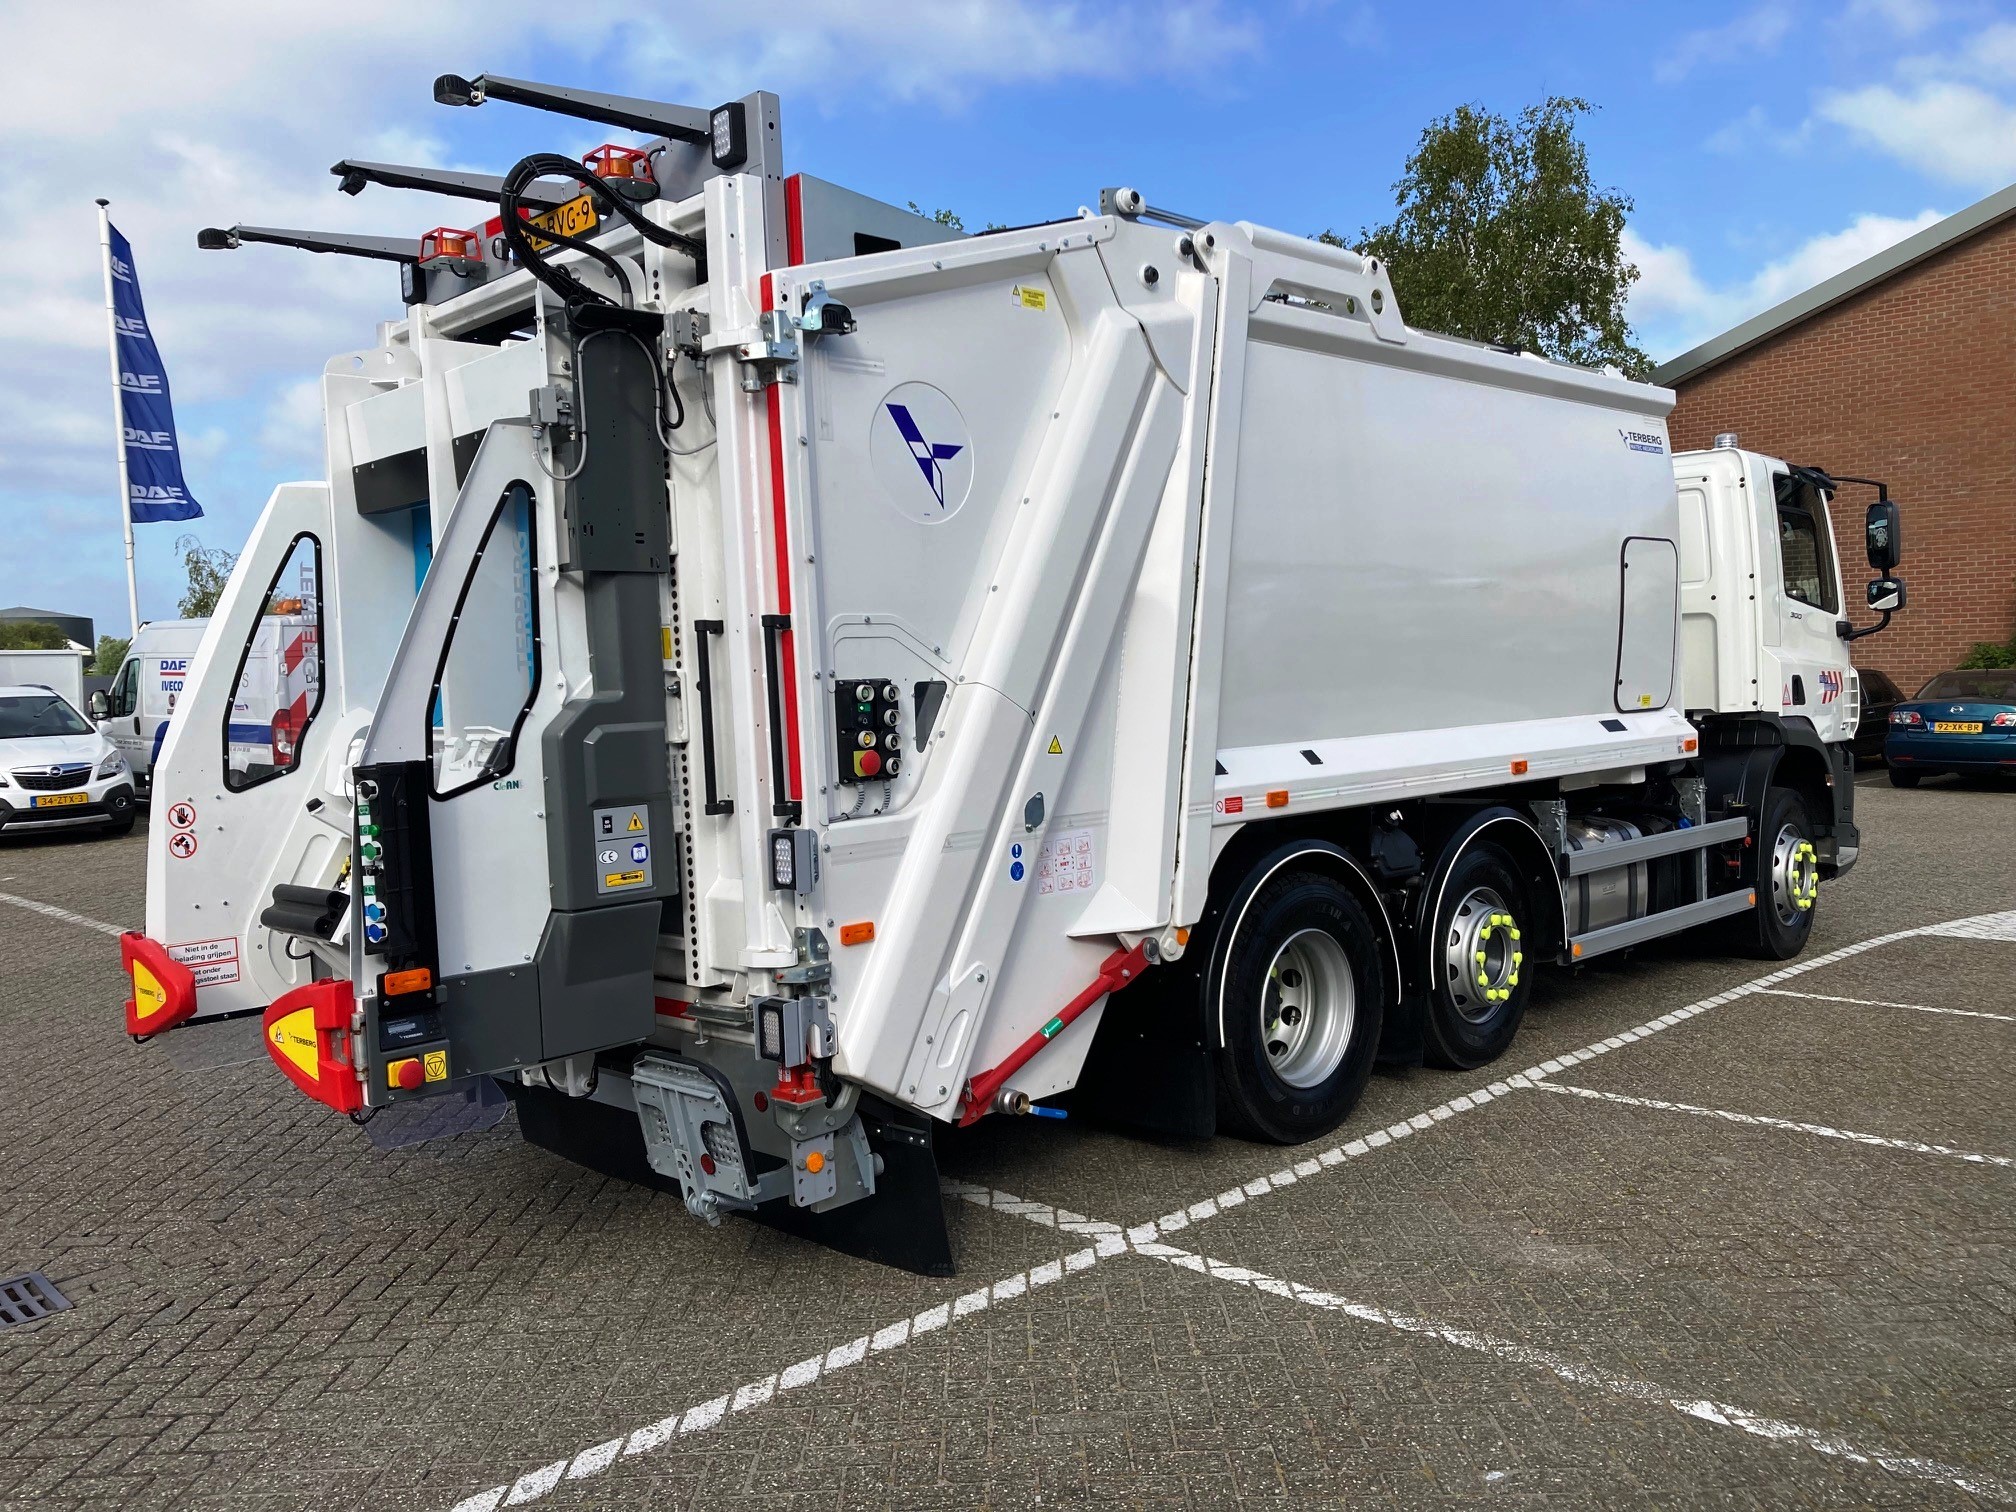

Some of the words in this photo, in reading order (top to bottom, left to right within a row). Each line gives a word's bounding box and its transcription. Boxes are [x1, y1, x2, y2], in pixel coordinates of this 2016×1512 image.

[121, 372, 160, 388] AF
[1628, 432, 1662, 445] TERBERG
[131, 484, 184, 499] DAF
[513, 531, 534, 673] TERBERG
[1790, 611, 1803, 620] 300
[160, 660, 187, 671] DAF
[161, 680, 184, 692] IVECO
[1937, 723, 1980, 732] 92-XK-BR
[41, 795, 84, 806] 34-ZTX-3
[185, 946, 200, 954] Niet
[206, 950, 232, 960] grijpen
[293, 1036, 317, 1049] TERBERG
